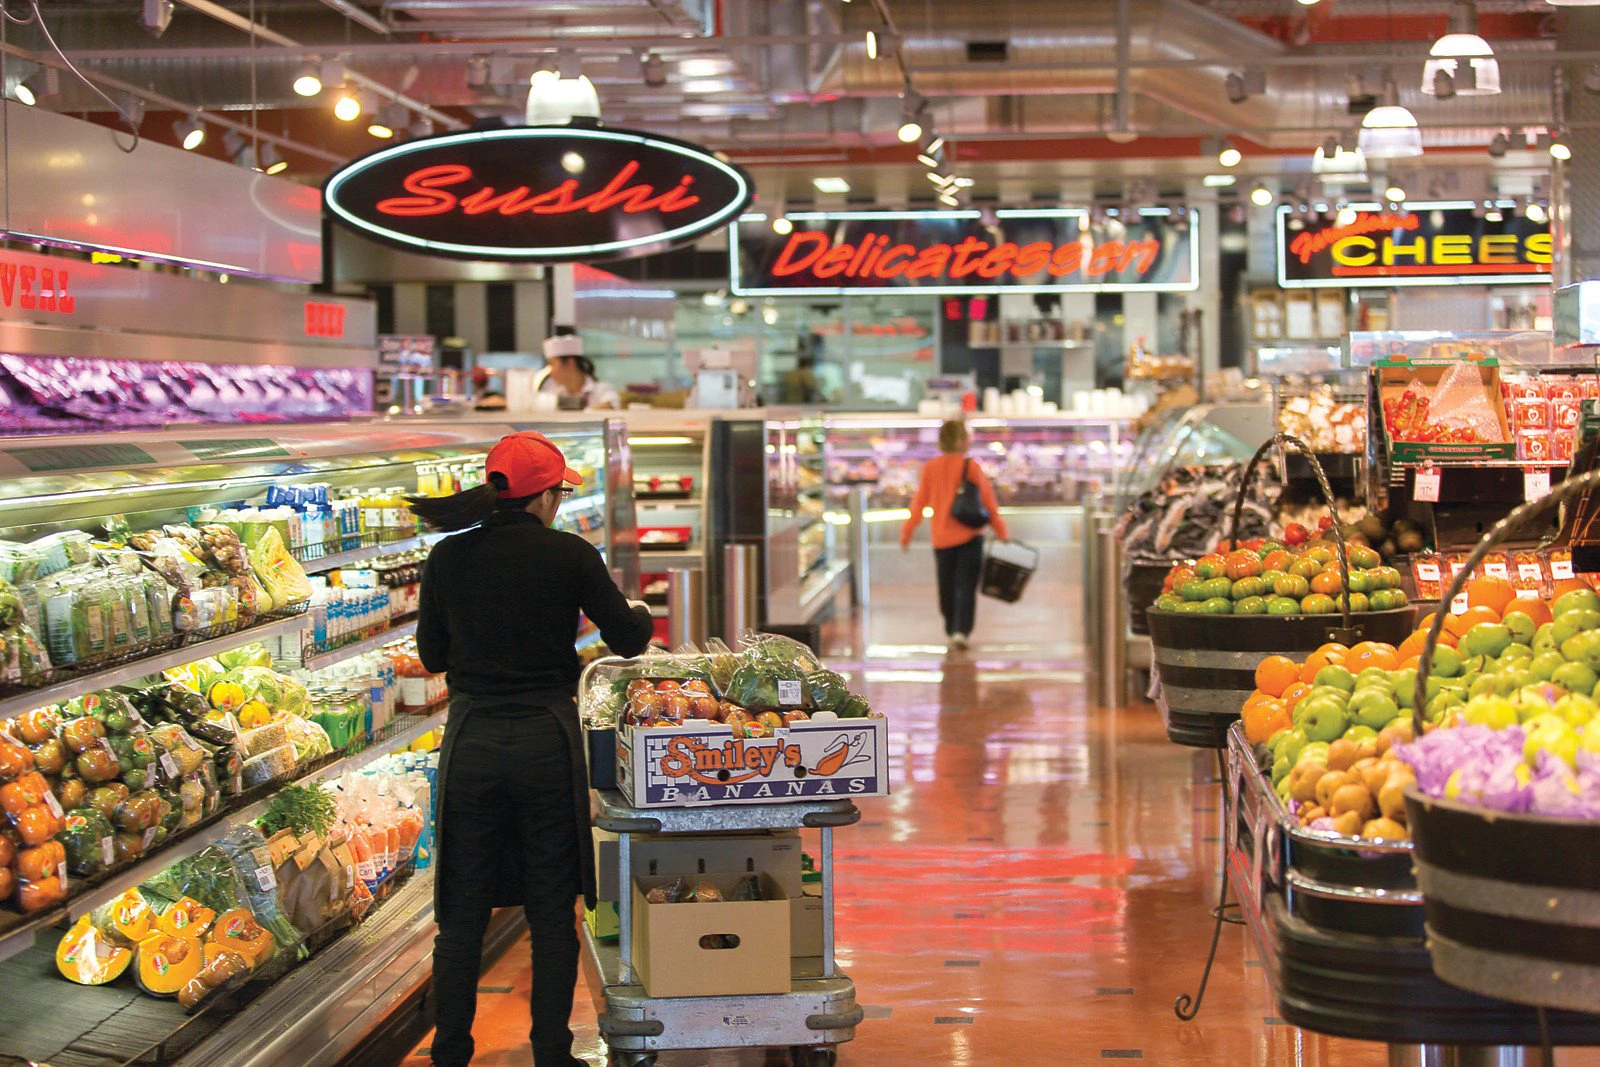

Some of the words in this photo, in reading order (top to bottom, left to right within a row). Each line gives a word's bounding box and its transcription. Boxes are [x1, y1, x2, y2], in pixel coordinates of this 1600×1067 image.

[376, 160, 700, 216] Sushi
[771, 231, 1161, 279] Delicatessen
[1331, 233, 1553, 266] CHEES
[0, 262, 76, 314] VEAL
[660, 736, 803, 784] Smiley's
[660, 778, 867, 803] BANANAS
